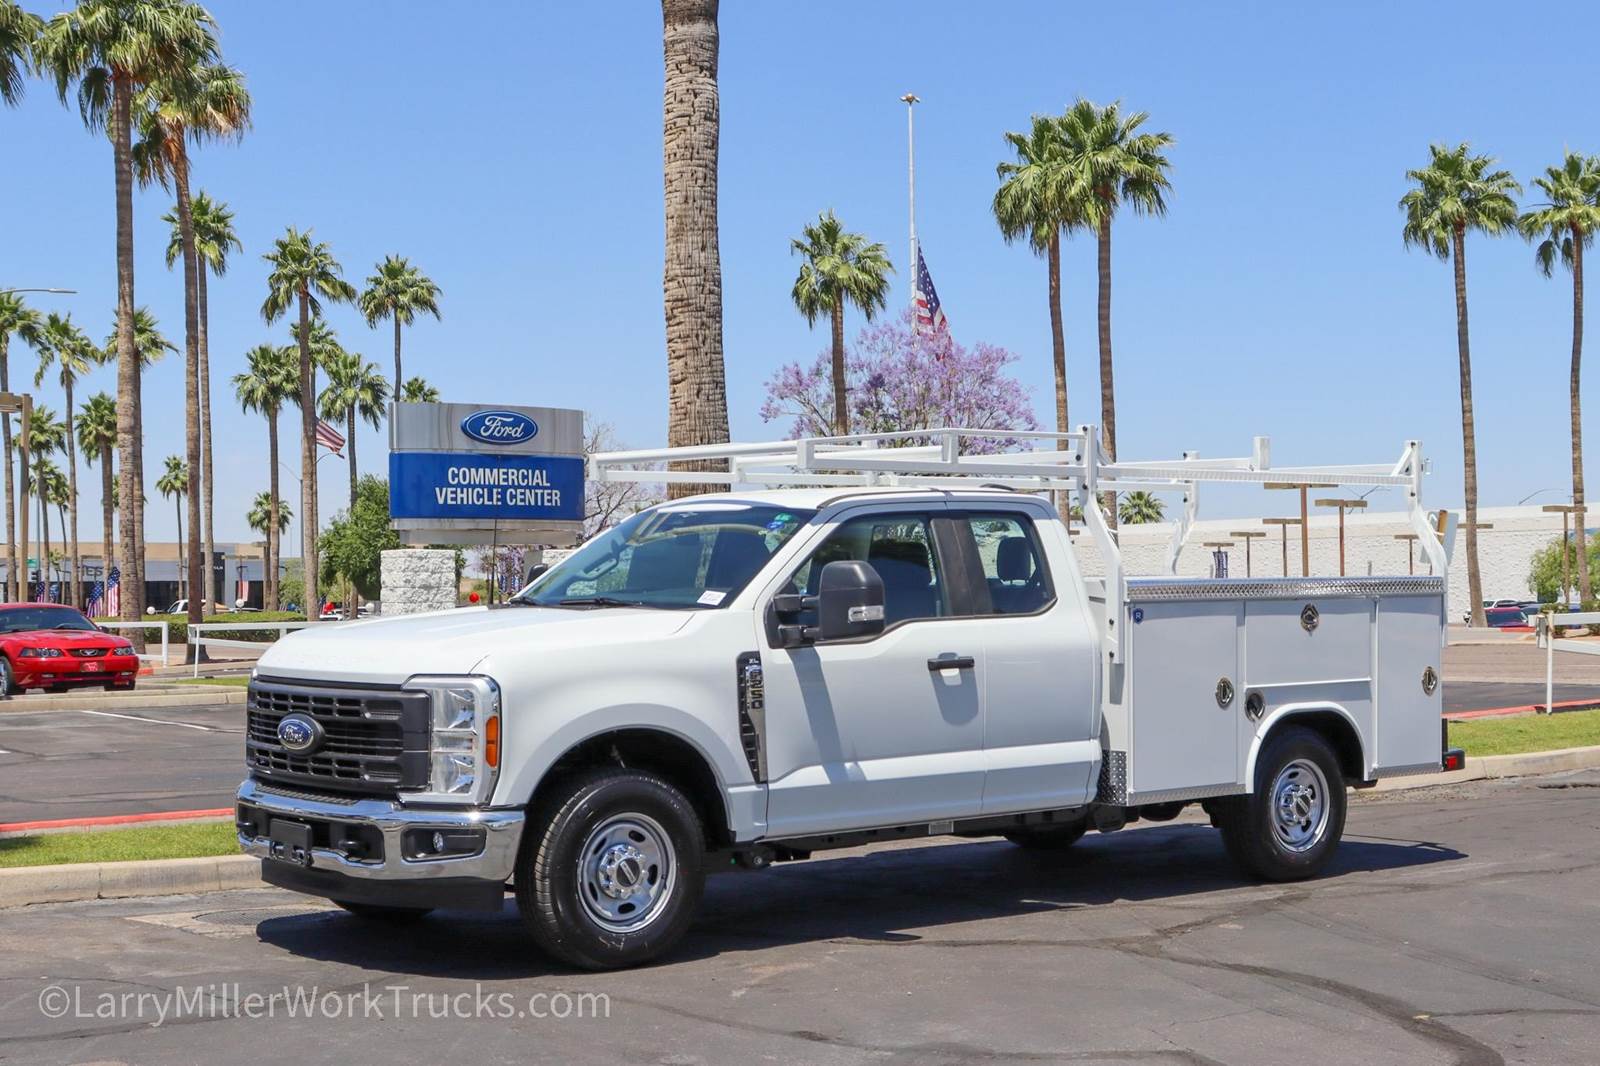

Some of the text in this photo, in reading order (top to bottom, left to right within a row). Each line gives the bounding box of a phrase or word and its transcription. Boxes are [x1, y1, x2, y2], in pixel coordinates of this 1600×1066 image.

[480, 415, 525, 438] Ford
[447, 466, 551, 487] COMMERCIAL
[435, 487, 561, 507] VEHICLE CENTER
[284, 724, 305, 743] Ford
